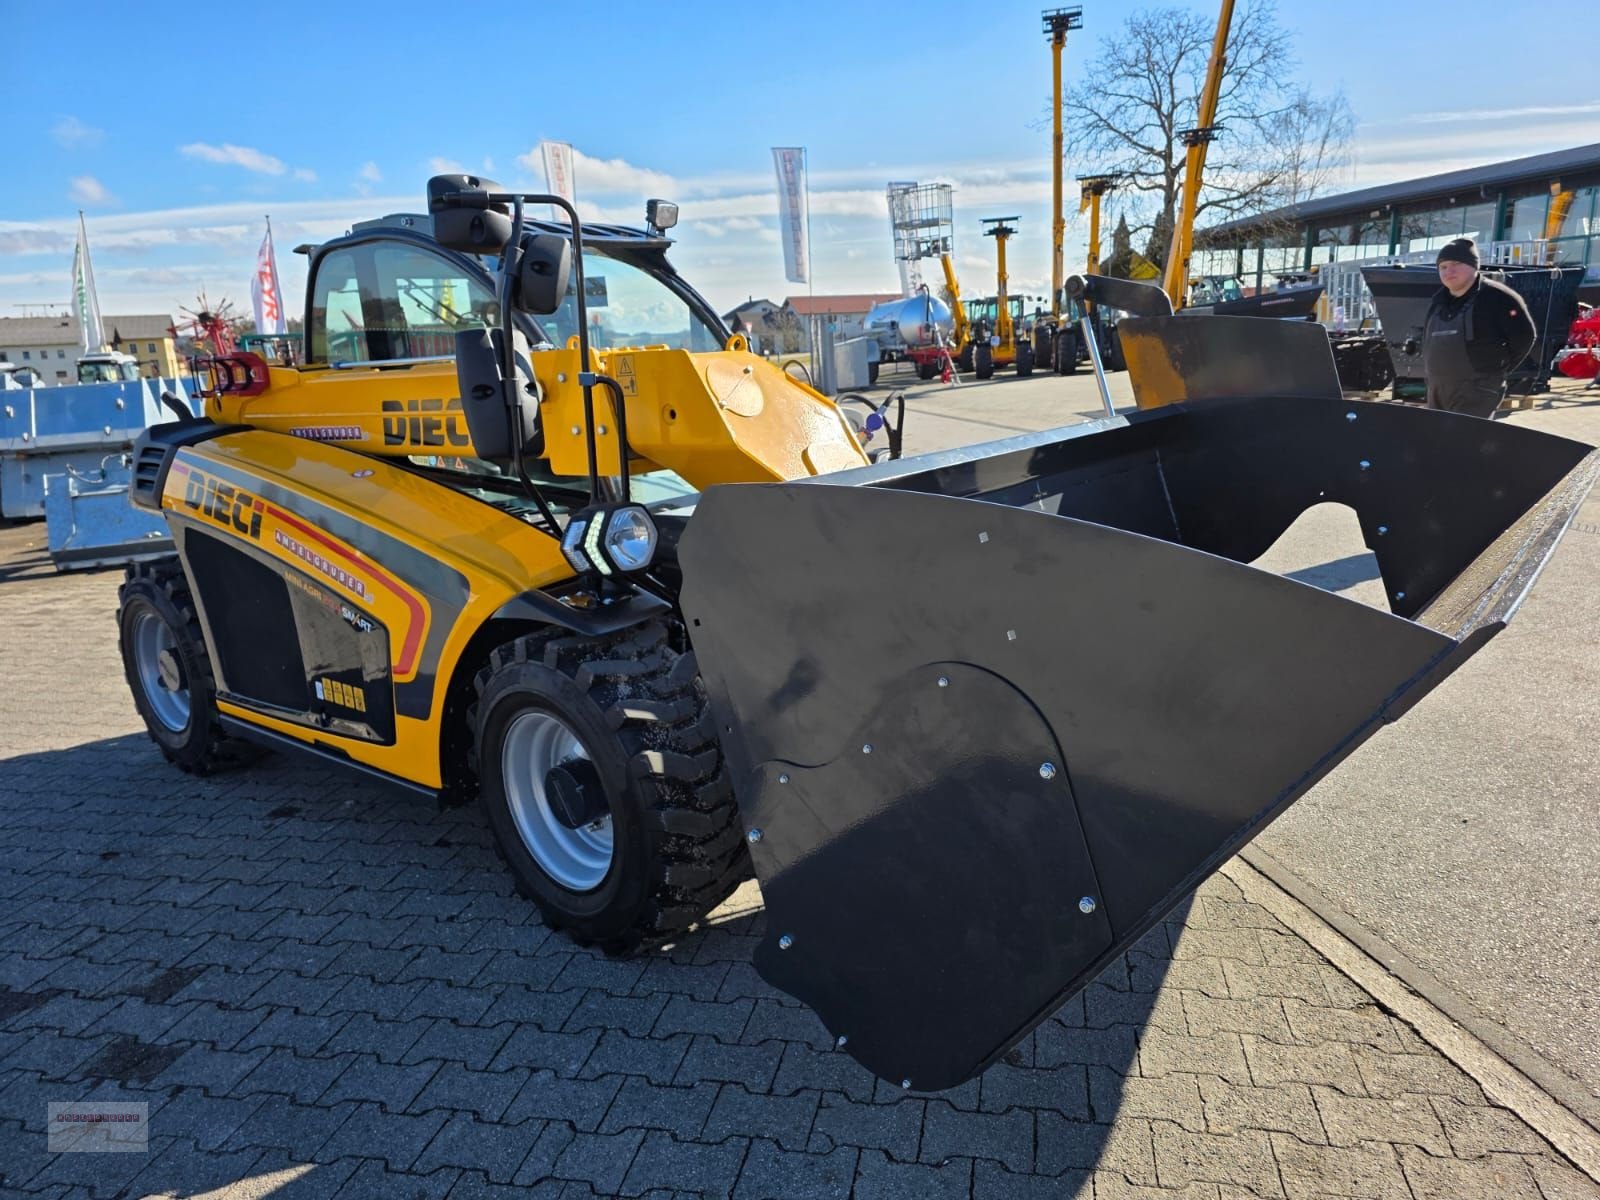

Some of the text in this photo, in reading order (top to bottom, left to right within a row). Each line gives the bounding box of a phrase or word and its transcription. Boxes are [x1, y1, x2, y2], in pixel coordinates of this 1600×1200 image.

[382, 399, 470, 446] DIEC
[185, 471, 264, 540] DIECI
[275, 530, 364, 596] AMSELGRUBER
[341, 606, 373, 633] SMART
